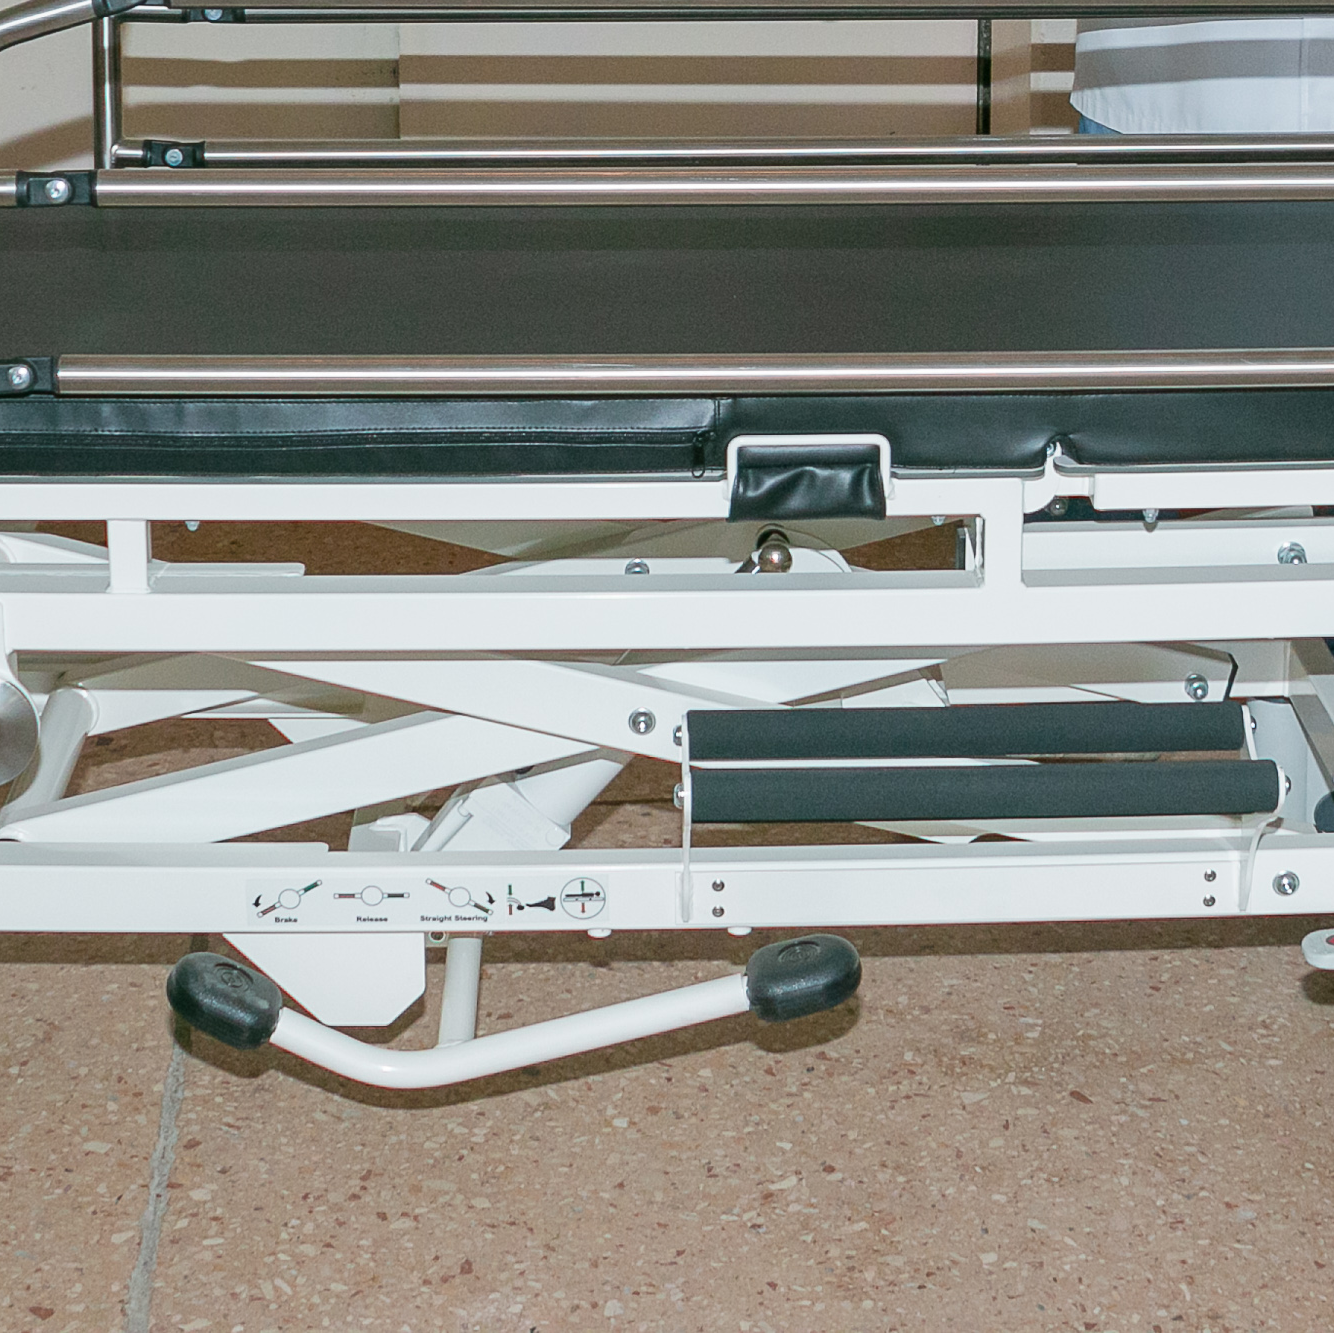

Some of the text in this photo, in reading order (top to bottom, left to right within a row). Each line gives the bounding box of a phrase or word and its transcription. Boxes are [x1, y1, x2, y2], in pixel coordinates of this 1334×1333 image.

[274, 916, 298, 924] Brake
[420, 914, 489, 923] Straight Steering
